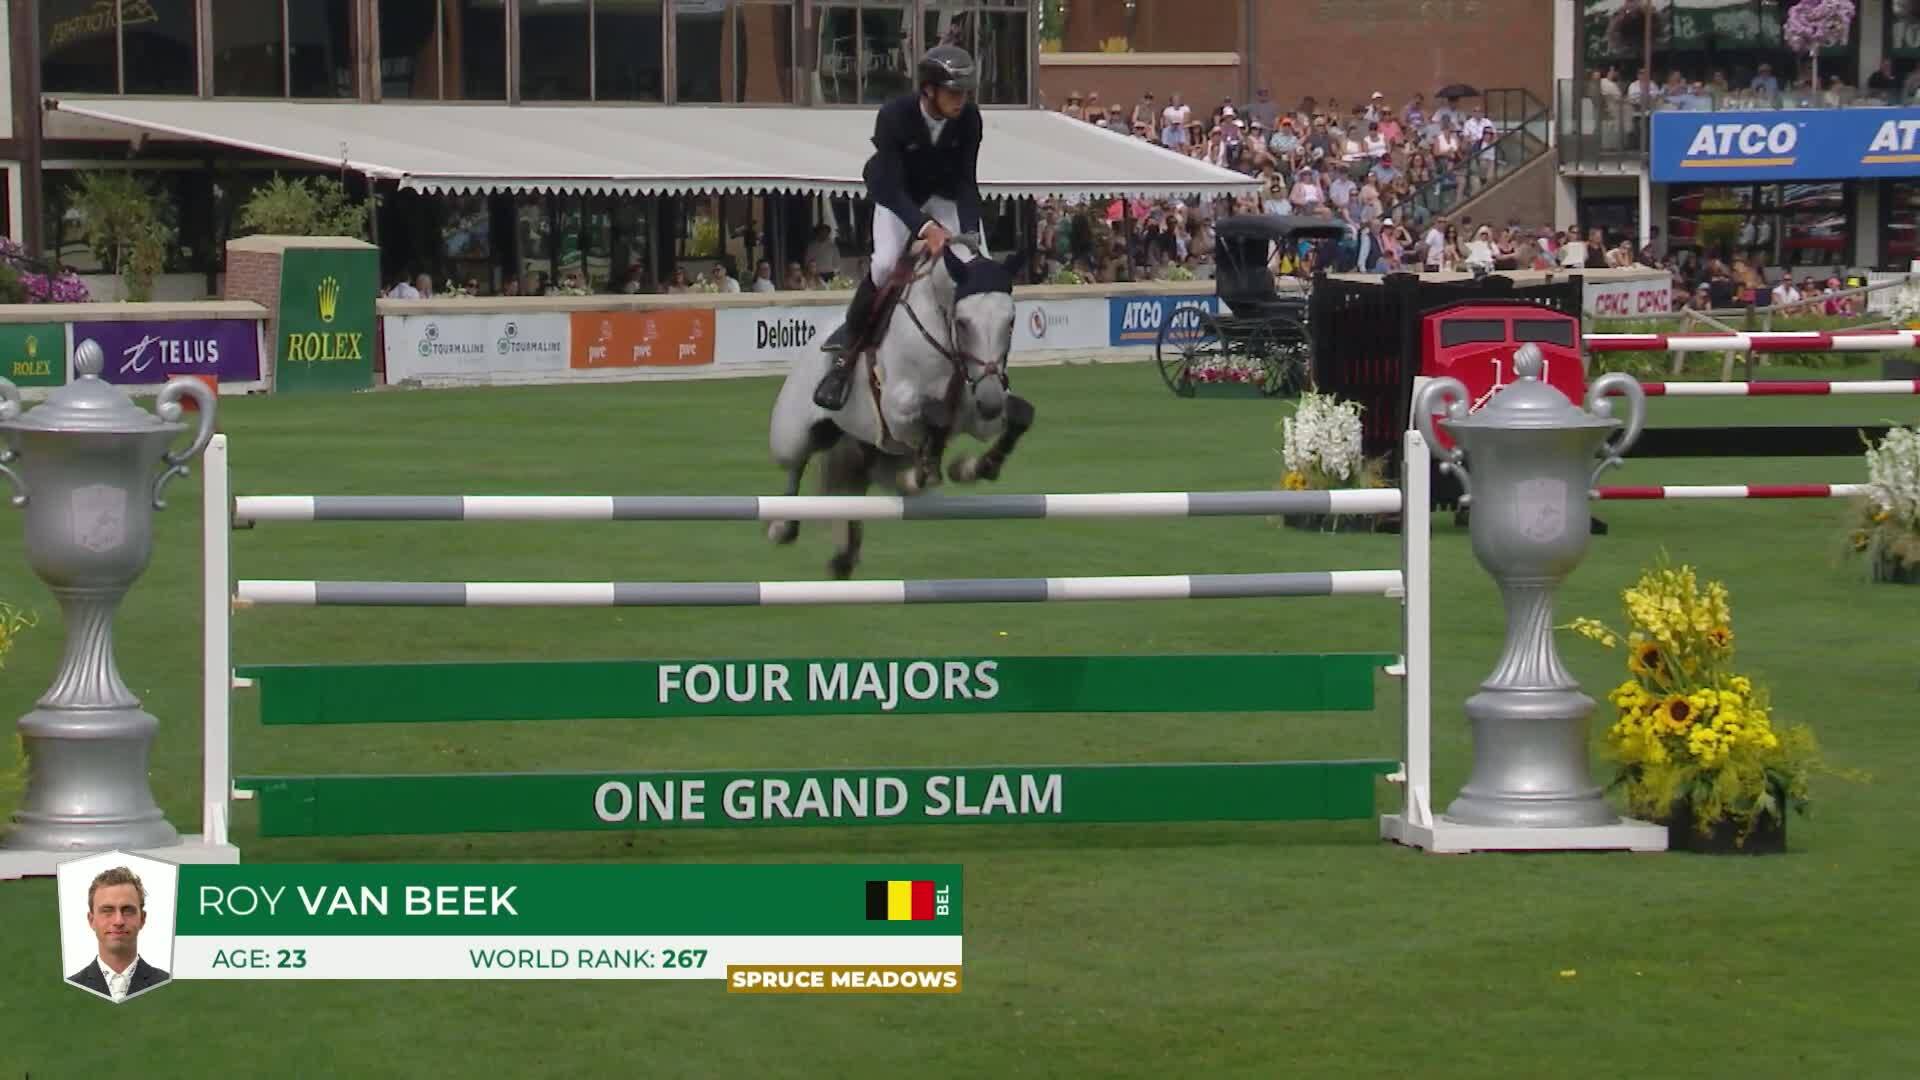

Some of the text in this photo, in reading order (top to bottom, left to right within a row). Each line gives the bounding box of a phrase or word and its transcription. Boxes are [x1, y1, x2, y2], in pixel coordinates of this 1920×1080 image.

[1687, 122, 1798, 155] ATCO
[1122, 301, 1162, 329] ATCO
[288, 332, 362, 361] ROLEX
[432, 343, 484, 354] TOURMALINE
[511, 341, 561, 352] TOURMALINE
[757, 320, 816, 349] Deloitte
[159, 340, 219, 363] TELUS
[13, 361, 51, 376] ROLEX
[657, 660, 1000, 710] FOUR MAJORS
[594, 773, 1064, 822] ONE GRAND SLAM
